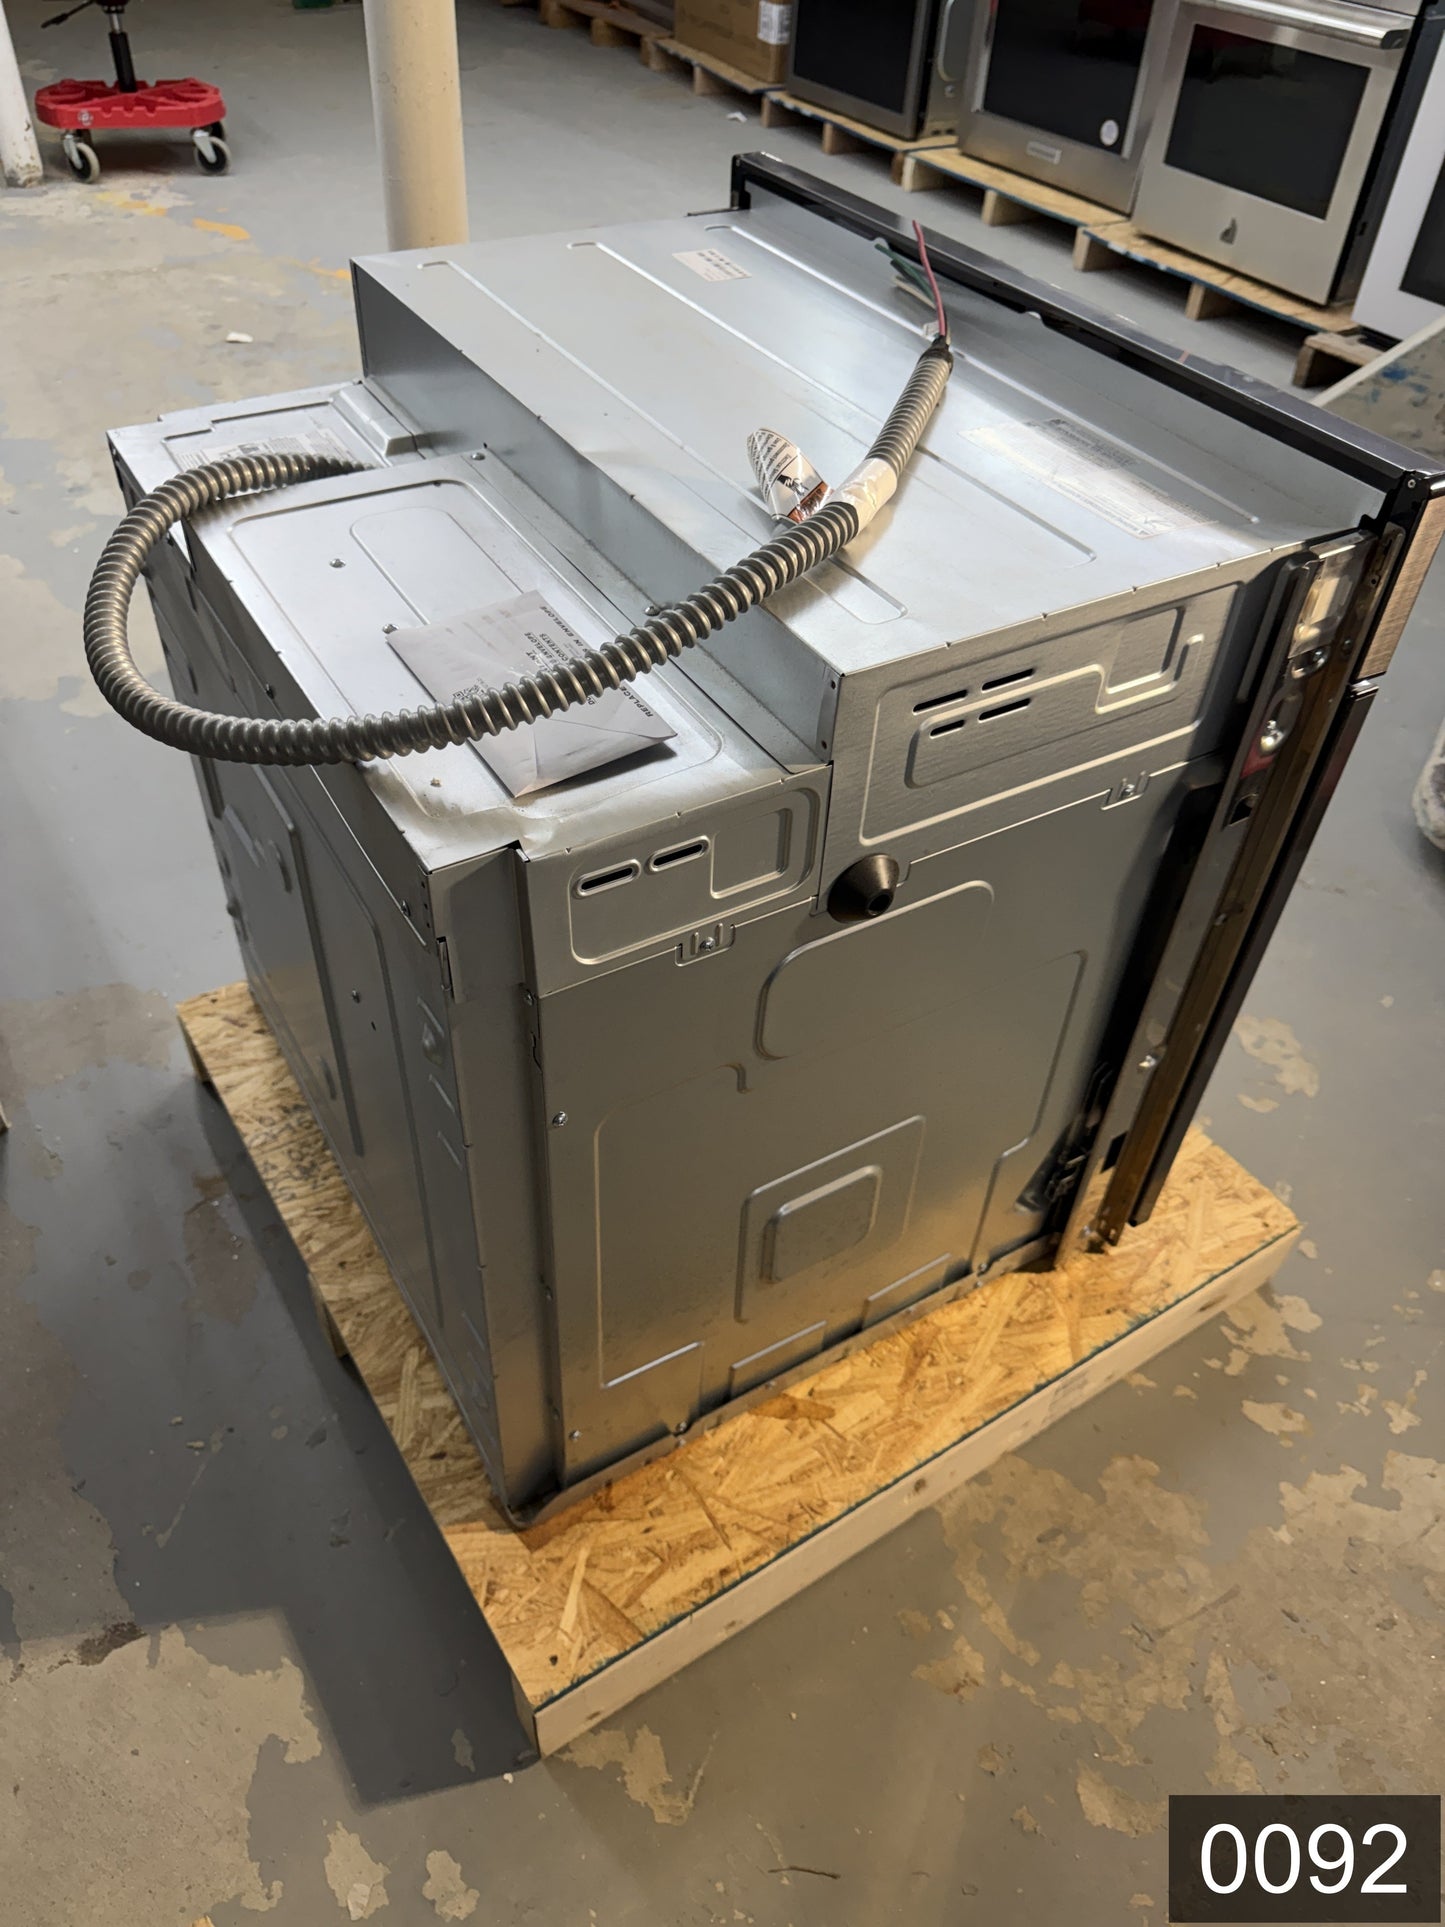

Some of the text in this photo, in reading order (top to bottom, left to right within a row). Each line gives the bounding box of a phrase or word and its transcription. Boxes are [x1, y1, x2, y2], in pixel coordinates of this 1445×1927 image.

[541, 606, 574, 637] ENVELOPE
[540, 633, 568, 661] CONTENTS
[574, 639, 583, 648] IN
[620, 686, 653, 717] REPLACE
